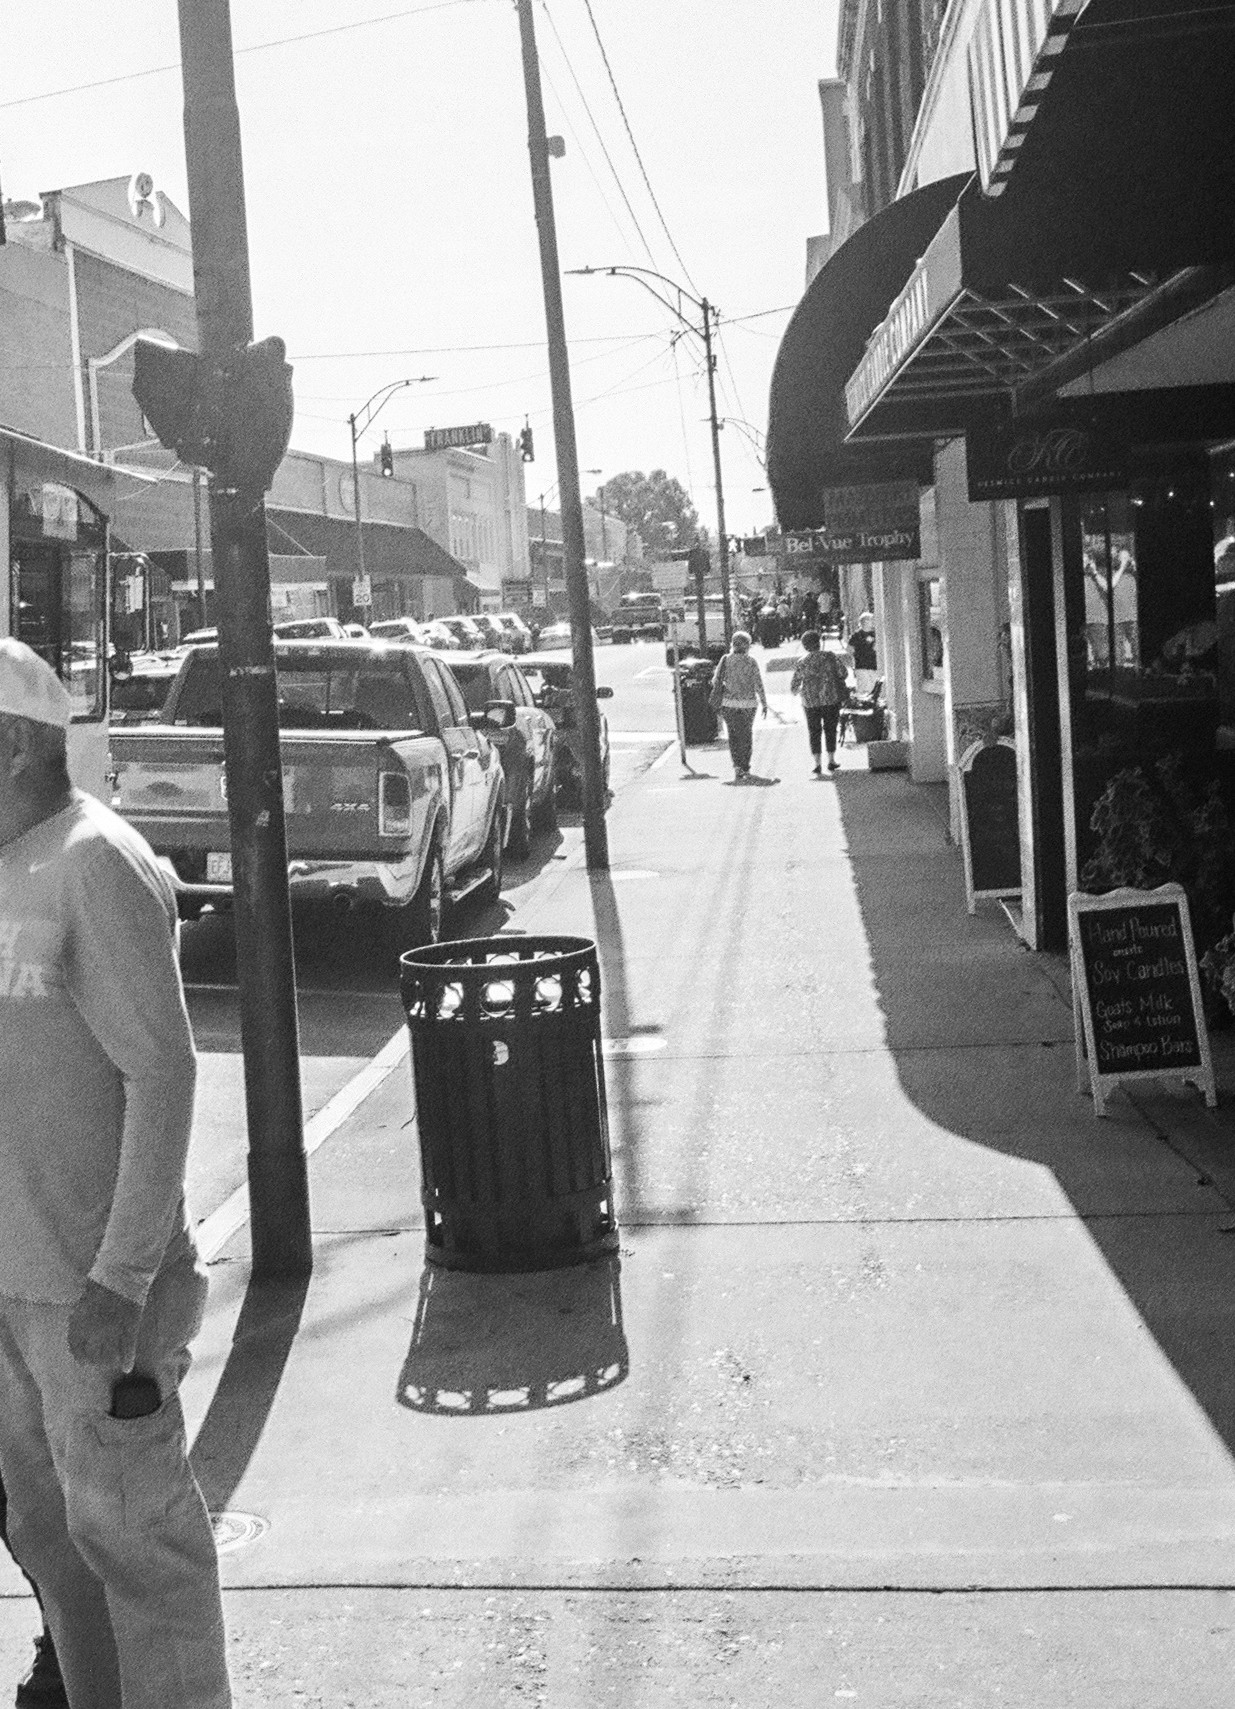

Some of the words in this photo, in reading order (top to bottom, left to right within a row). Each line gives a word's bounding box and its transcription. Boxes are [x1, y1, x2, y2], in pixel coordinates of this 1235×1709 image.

[856, 530, 914, 549] Trophy
[355, 593, 370, 603] 20
[1129, 916, 1178, 942] Poured
[1092, 960, 1119, 985] Soy
[1126, 956, 1186, 980] Candles
[1139, 993, 1173, 1012] Milk
[1100, 1039, 1159, 1062] Shampoo
[1161, 1034, 1194, 1056] Bars
